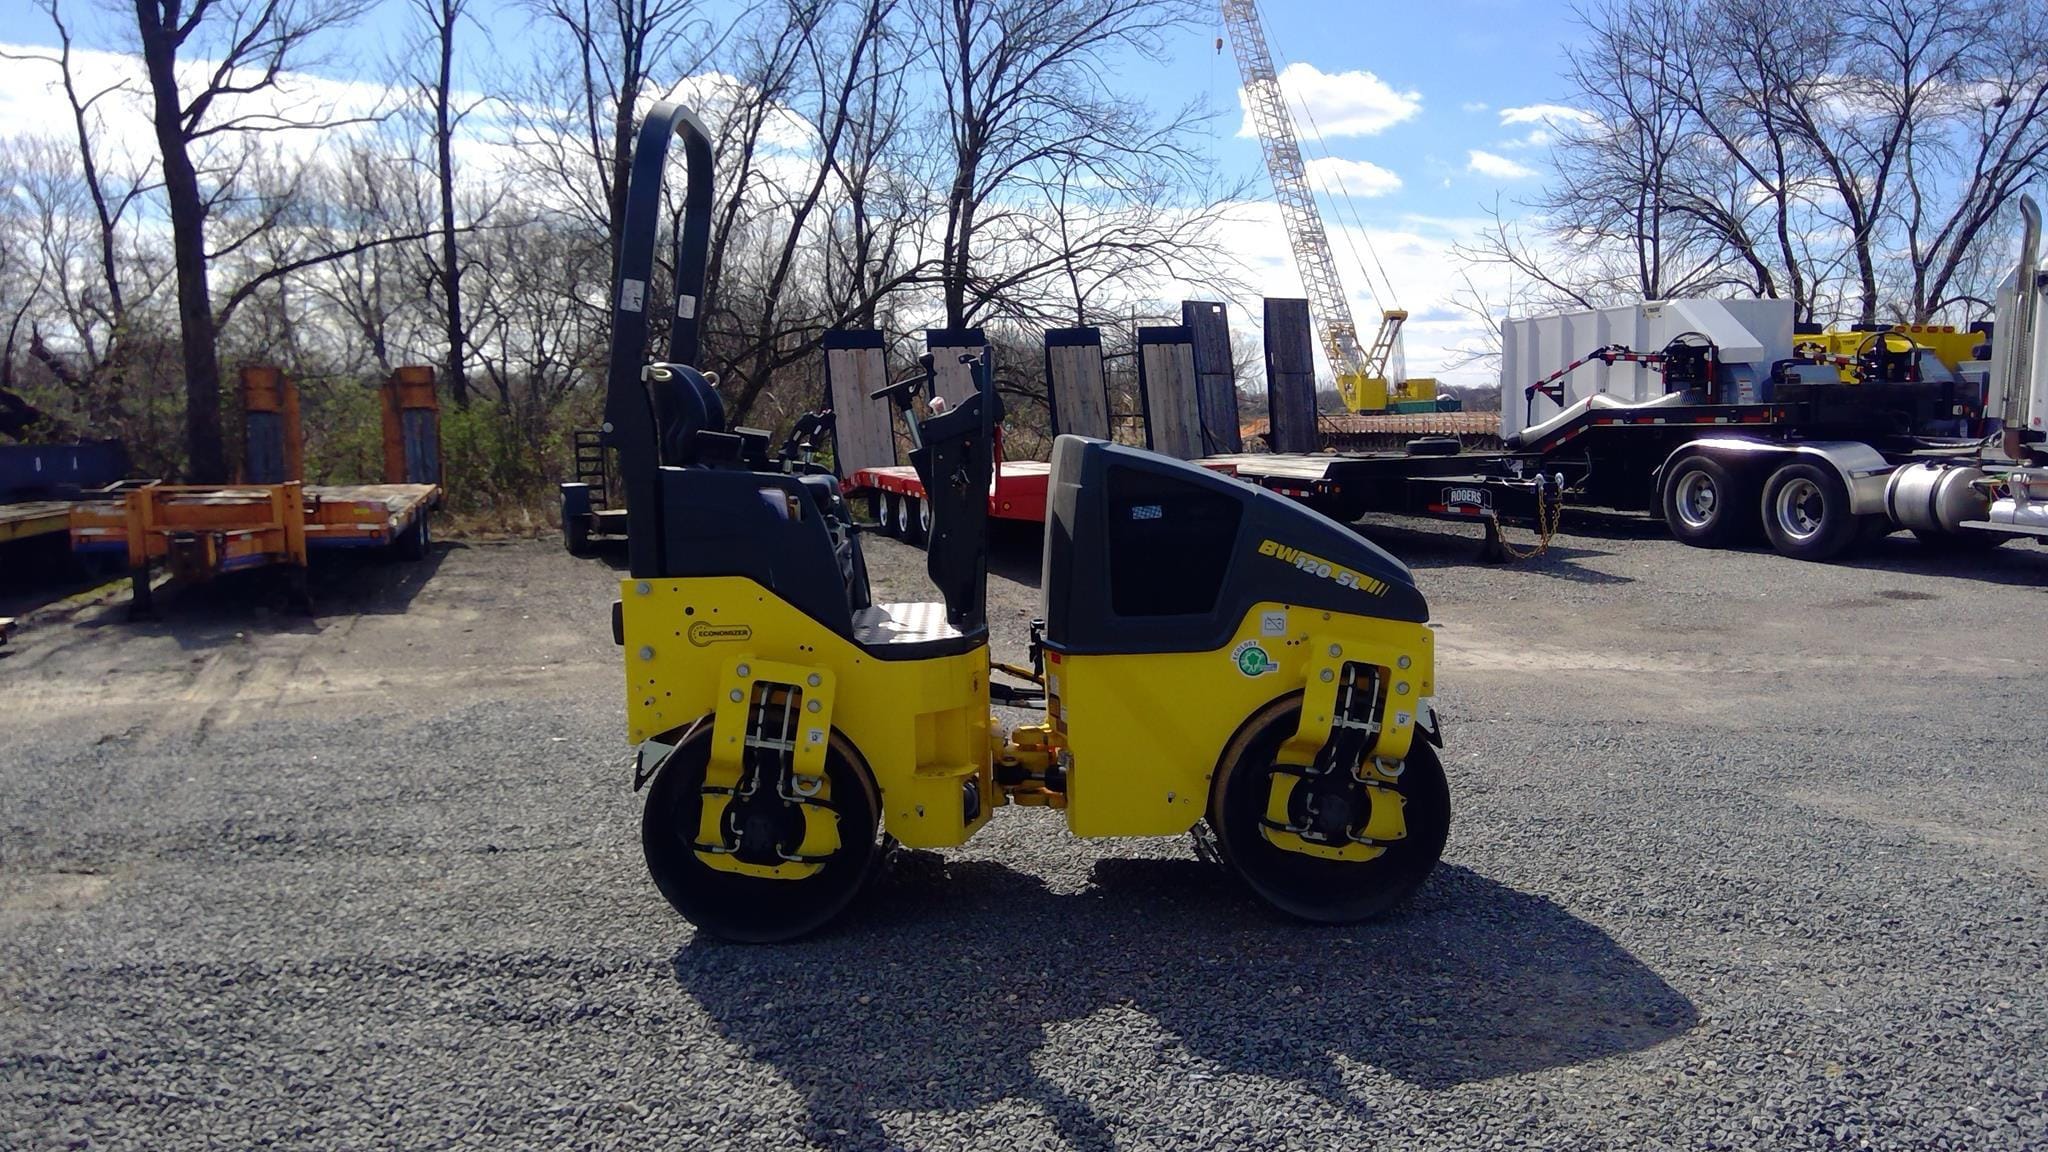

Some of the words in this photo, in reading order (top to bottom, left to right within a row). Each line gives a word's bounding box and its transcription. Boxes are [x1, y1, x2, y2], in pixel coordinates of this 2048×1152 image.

[1451, 490, 1481, 504] ROGERS
[1336, 572, 1360, 590] SL
[698, 629, 749, 638] ECONOMIZER
[1232, 641, 1257, 660] ECOLOGY
